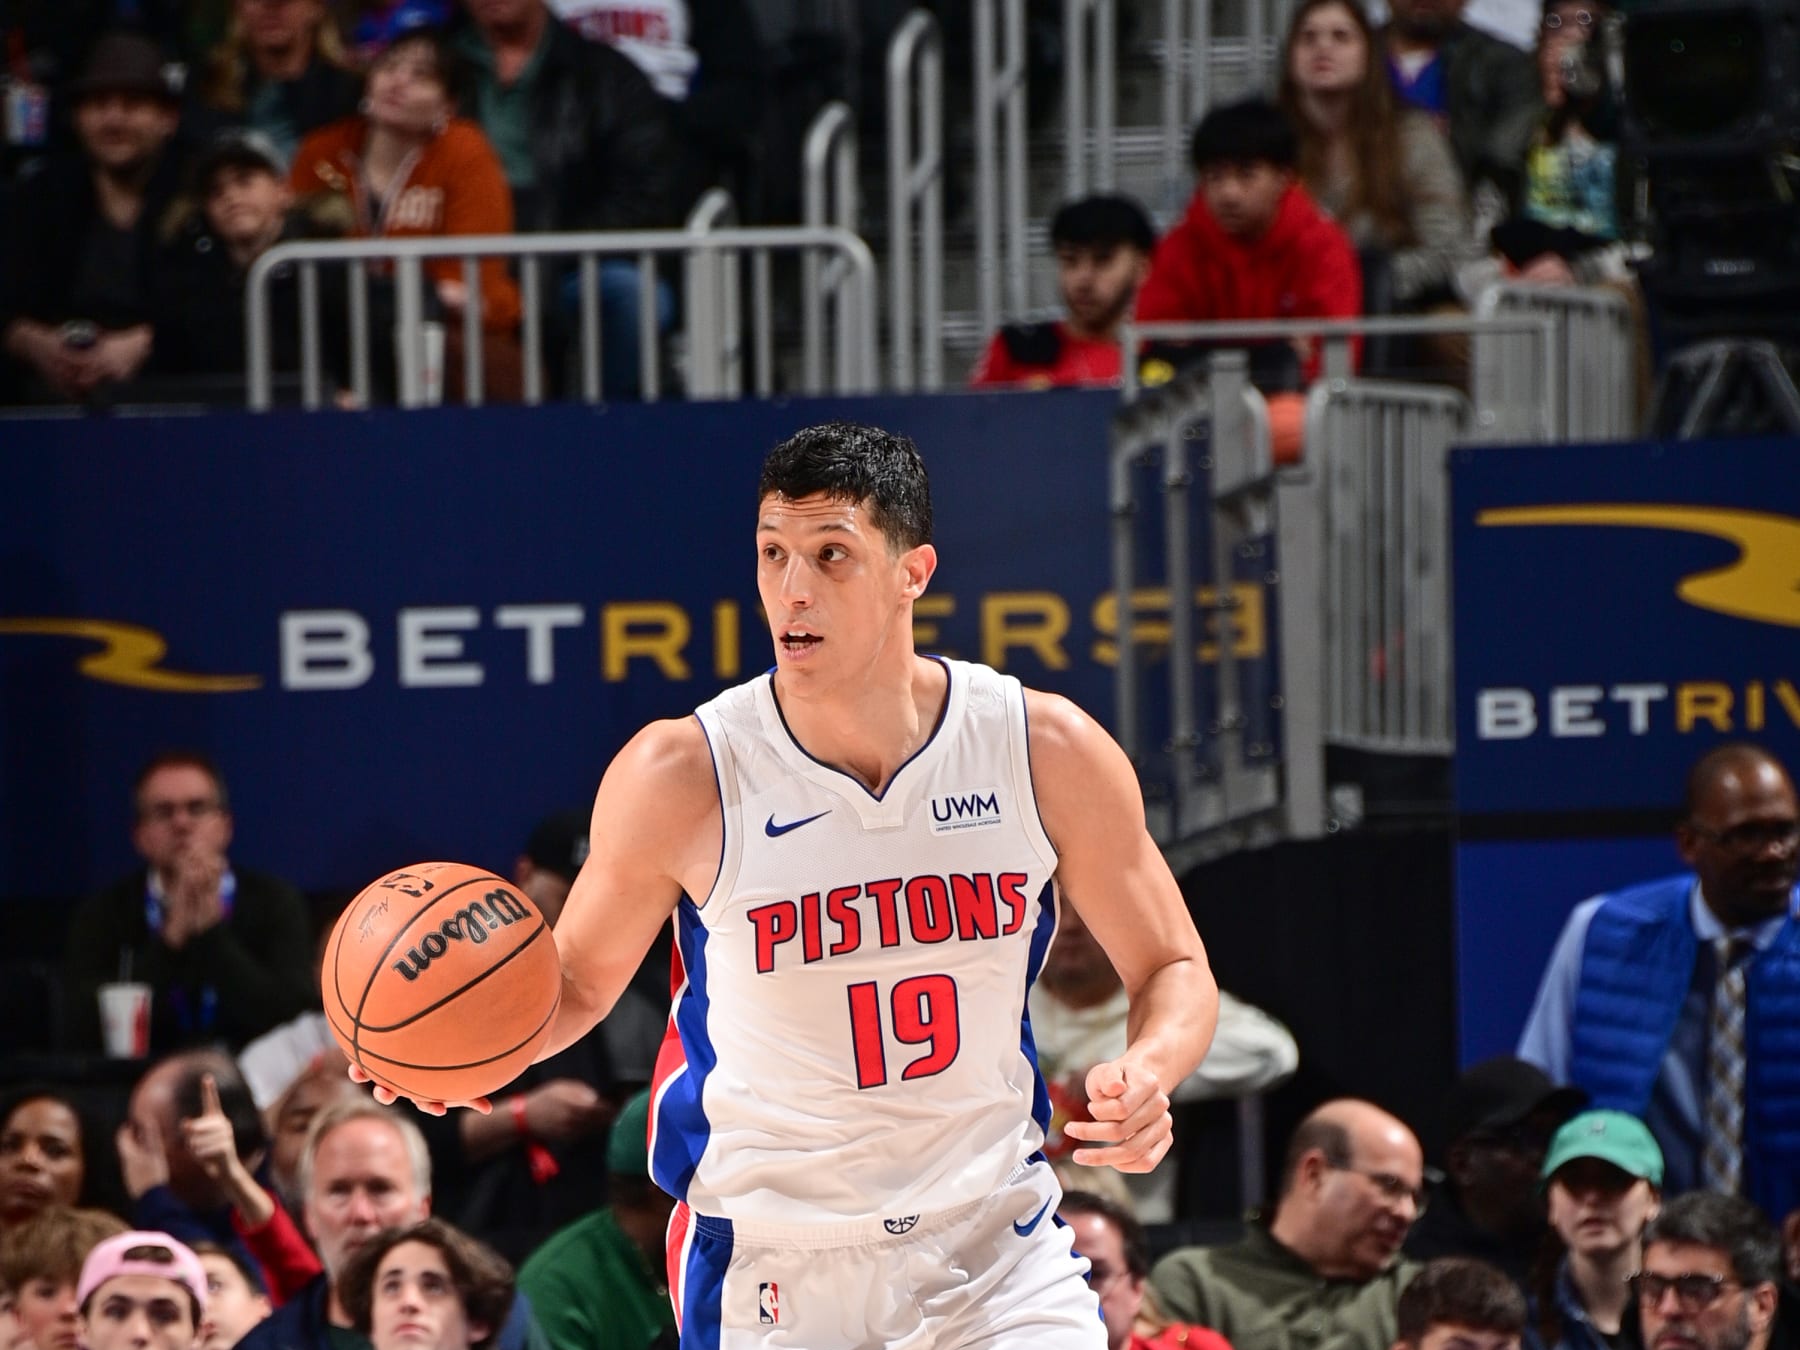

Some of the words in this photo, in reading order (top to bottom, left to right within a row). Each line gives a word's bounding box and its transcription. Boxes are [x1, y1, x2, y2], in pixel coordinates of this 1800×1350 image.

[931, 792, 1000, 821] UWM
[391, 887, 533, 982] Wilson
[746, 872, 1028, 974] PISTONS
[847, 973, 961, 1090] 19
